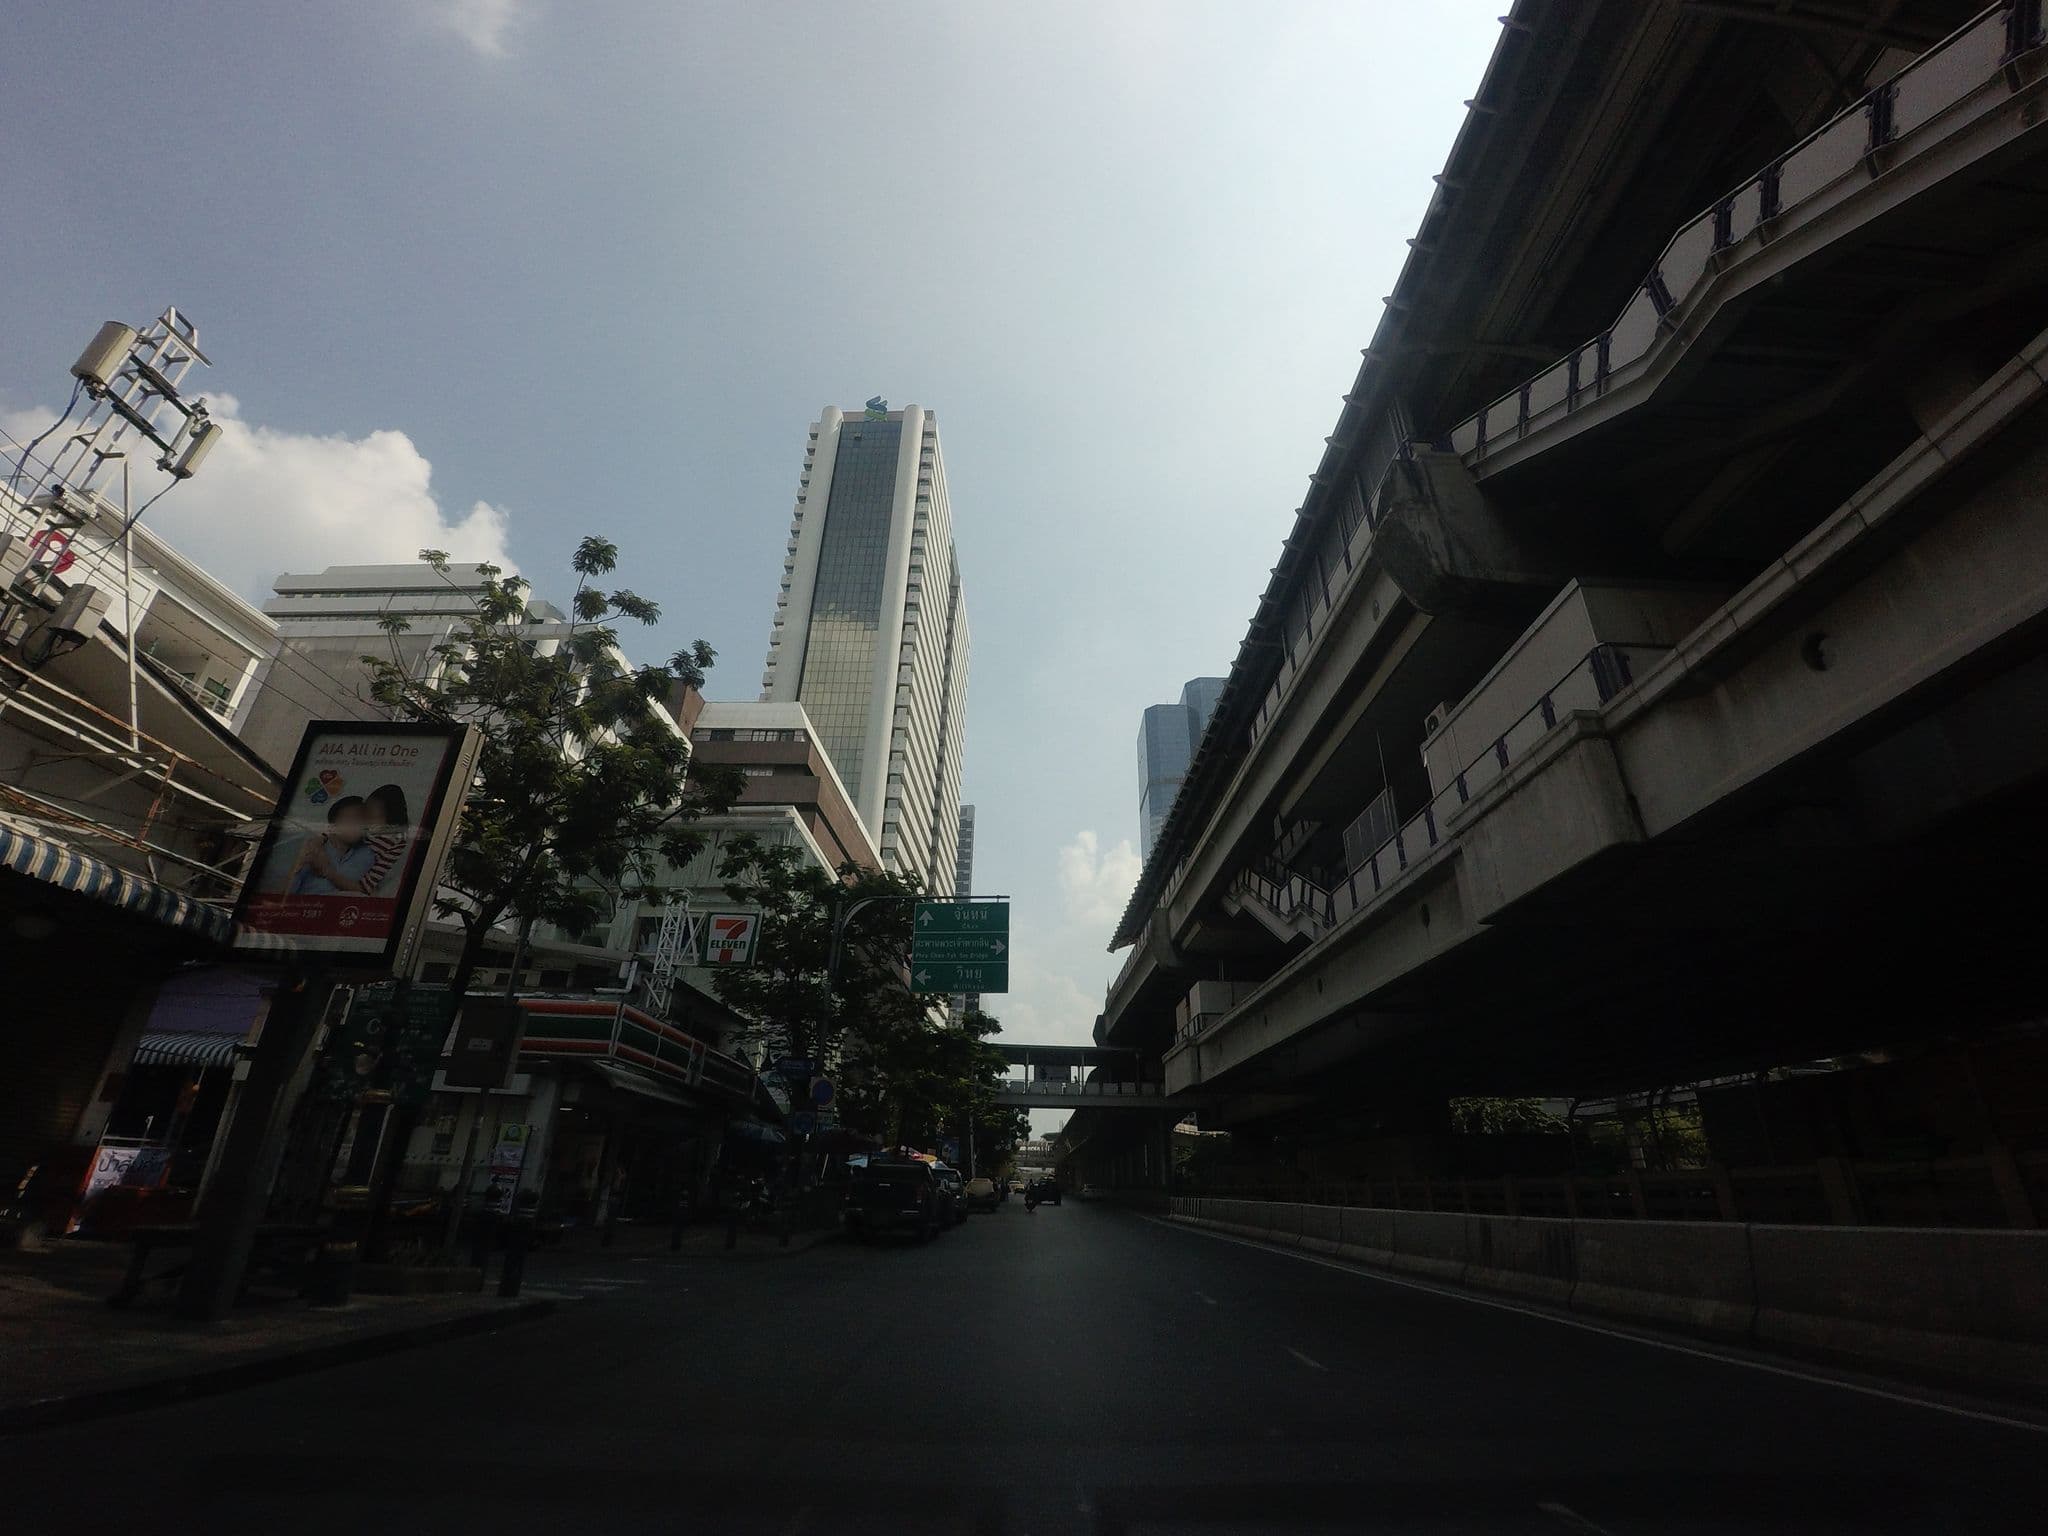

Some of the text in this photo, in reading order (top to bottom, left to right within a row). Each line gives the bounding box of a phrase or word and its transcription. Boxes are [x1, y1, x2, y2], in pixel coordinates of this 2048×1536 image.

[320, 743, 419, 757] AIA All in One
[716, 919, 748, 961] 7
